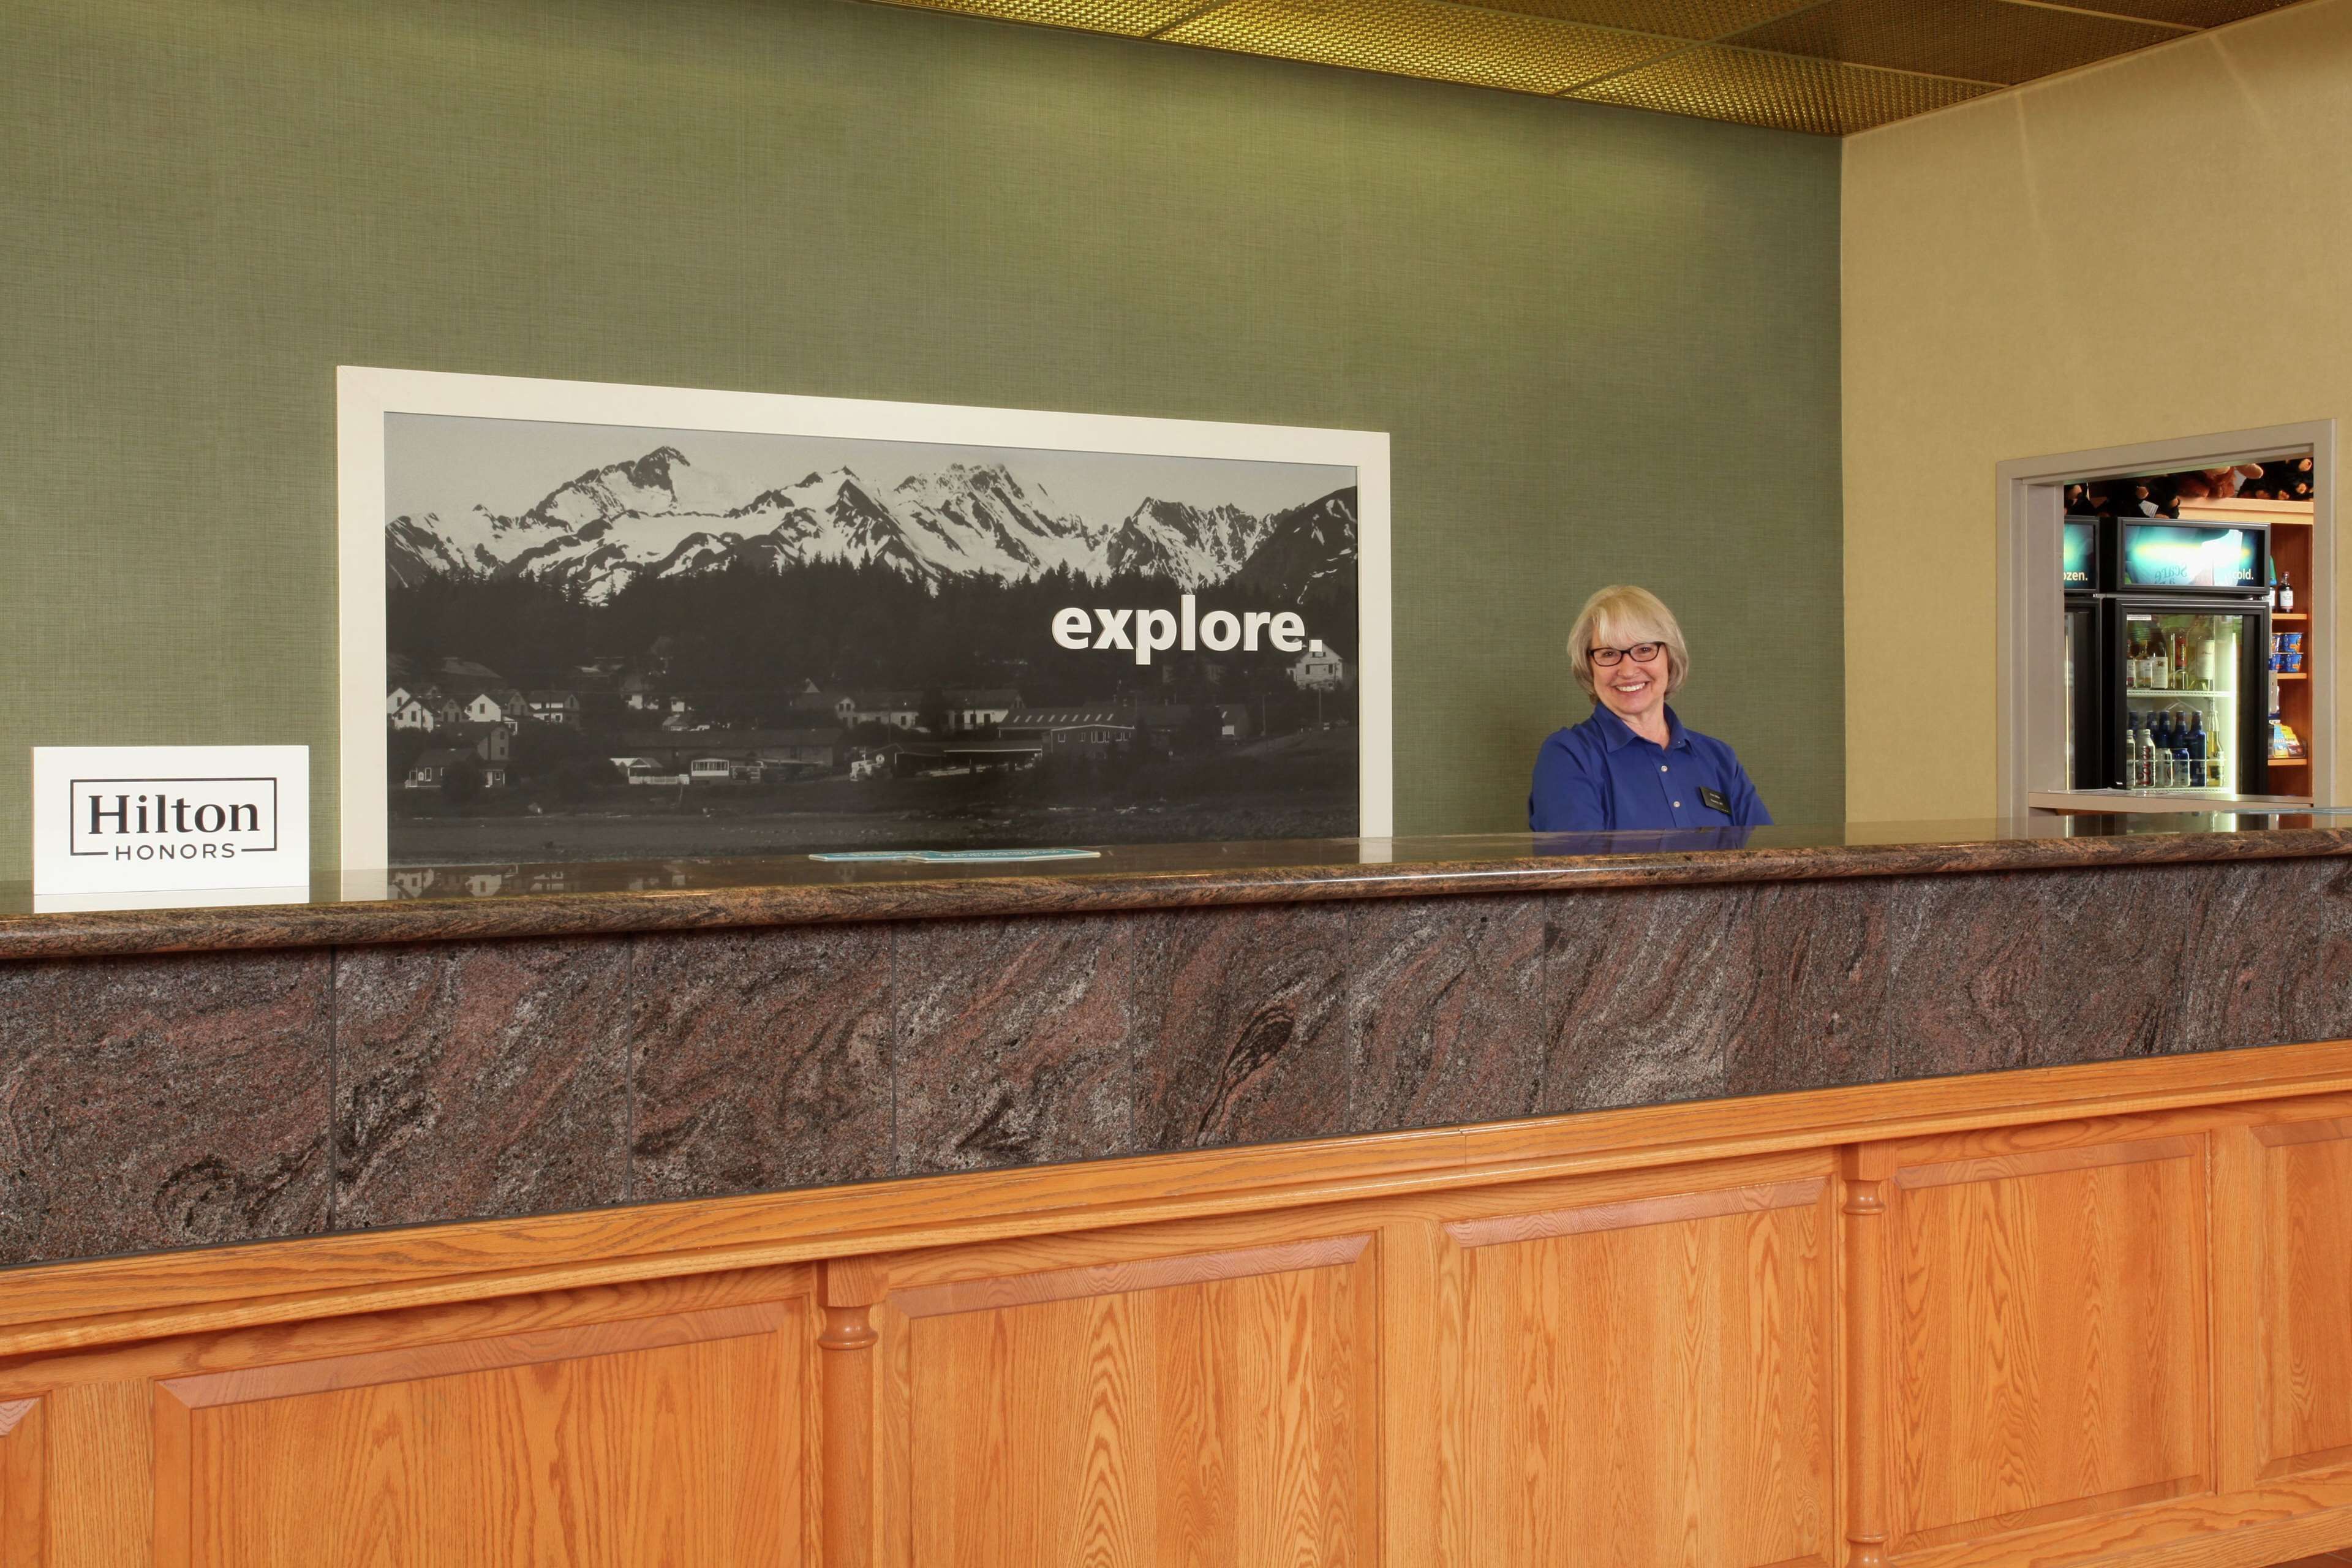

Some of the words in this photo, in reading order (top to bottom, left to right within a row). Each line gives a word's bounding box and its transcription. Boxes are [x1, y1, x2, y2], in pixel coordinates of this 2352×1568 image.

[2233, 568, 2254, 580] cold.
[1052, 594, 1322, 665] explore.
[88, 794, 261, 835] Hilton
[115, 843, 235, 861] HONORS
